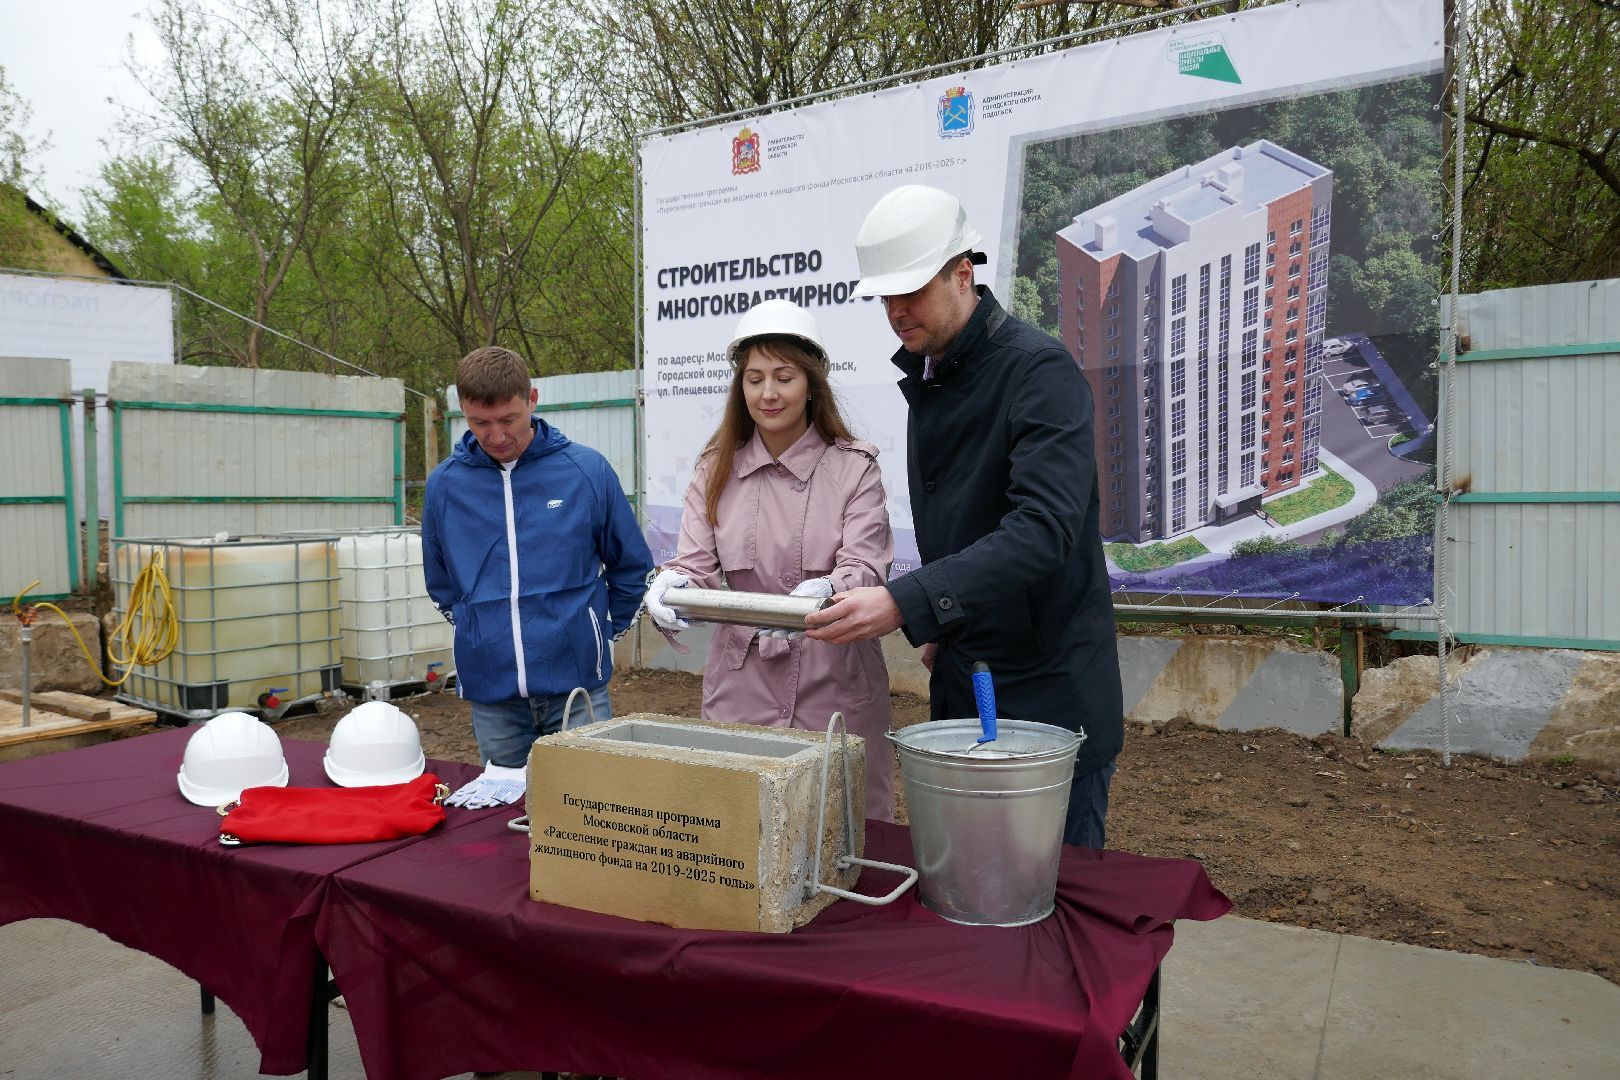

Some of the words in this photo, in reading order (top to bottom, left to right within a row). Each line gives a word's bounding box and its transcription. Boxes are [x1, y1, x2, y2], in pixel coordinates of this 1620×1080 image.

[982, 88, 1034, 104] АДМИНИСТРАЦИЯ
[982, 99, 1019, 111] ГОРОДСКОГО
[1019, 94, 1042, 104] ОКРУГА
[982, 107, 1013, 119] ПОДОЛЬСК
[830, 173, 874, 187] Московской
[874, 168, 904, 179] области
[657, 249, 822, 289] СТРОИТЕЛЬСТВО
[657, 356, 669, 366] по
[670, 354, 705, 367] адресу:
[657, 367, 705, 383] Городской
[657, 388, 671, 399] ул.
[891, 562, 911, 572] года
[563, 793, 654, 819] Государственная
[656, 810, 721, 829] программа
[583, 813, 649, 836] Московской
[652, 825, 699, 844] области
[543, 825, 609, 847] «Расселение
[611, 838, 658, 856] граждан
[660, 846, 674, 858] из
[676, 850, 745, 870] аварийного
[534, 843, 596, 863] жилищного
[598, 851, 633, 868] фонда
[635, 860, 648, 872] на
[651, 860, 716, 884] 2019-2025
[719, 874, 756, 890] годы»
